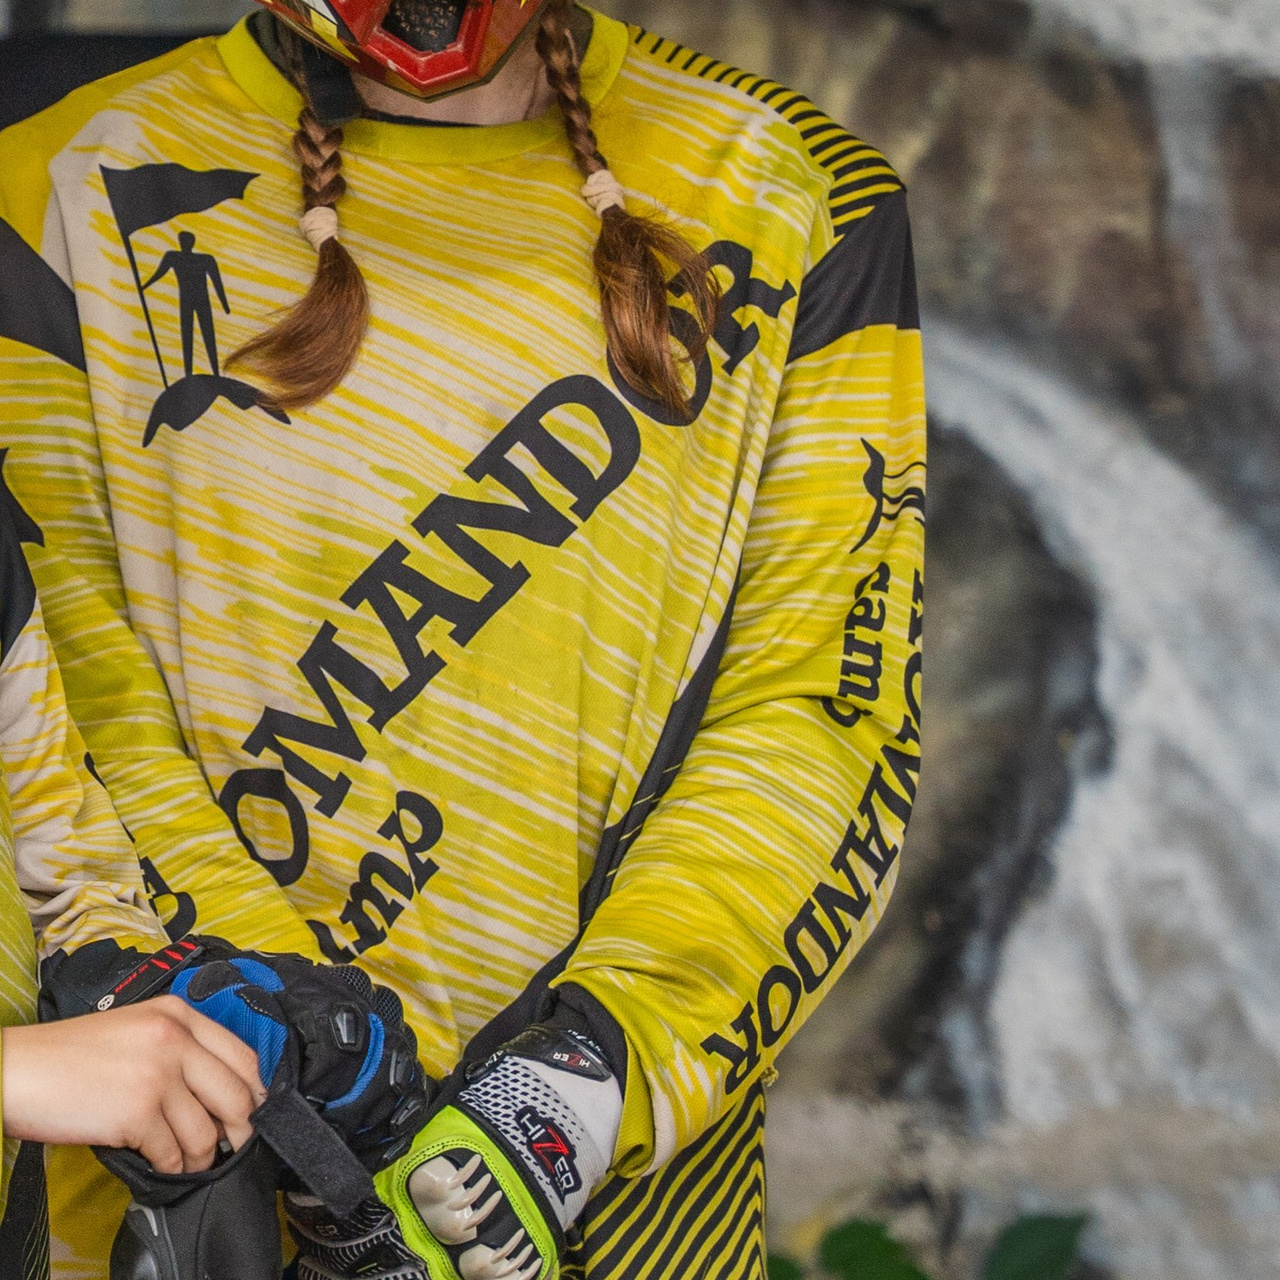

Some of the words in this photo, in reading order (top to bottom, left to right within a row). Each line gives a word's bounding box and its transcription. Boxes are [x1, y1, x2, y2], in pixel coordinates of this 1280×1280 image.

[220, 239, 798, 887] OMANDOR
[552, 1051, 591, 1069] HIZER
[521, 1112, 575, 1191] HIZER
